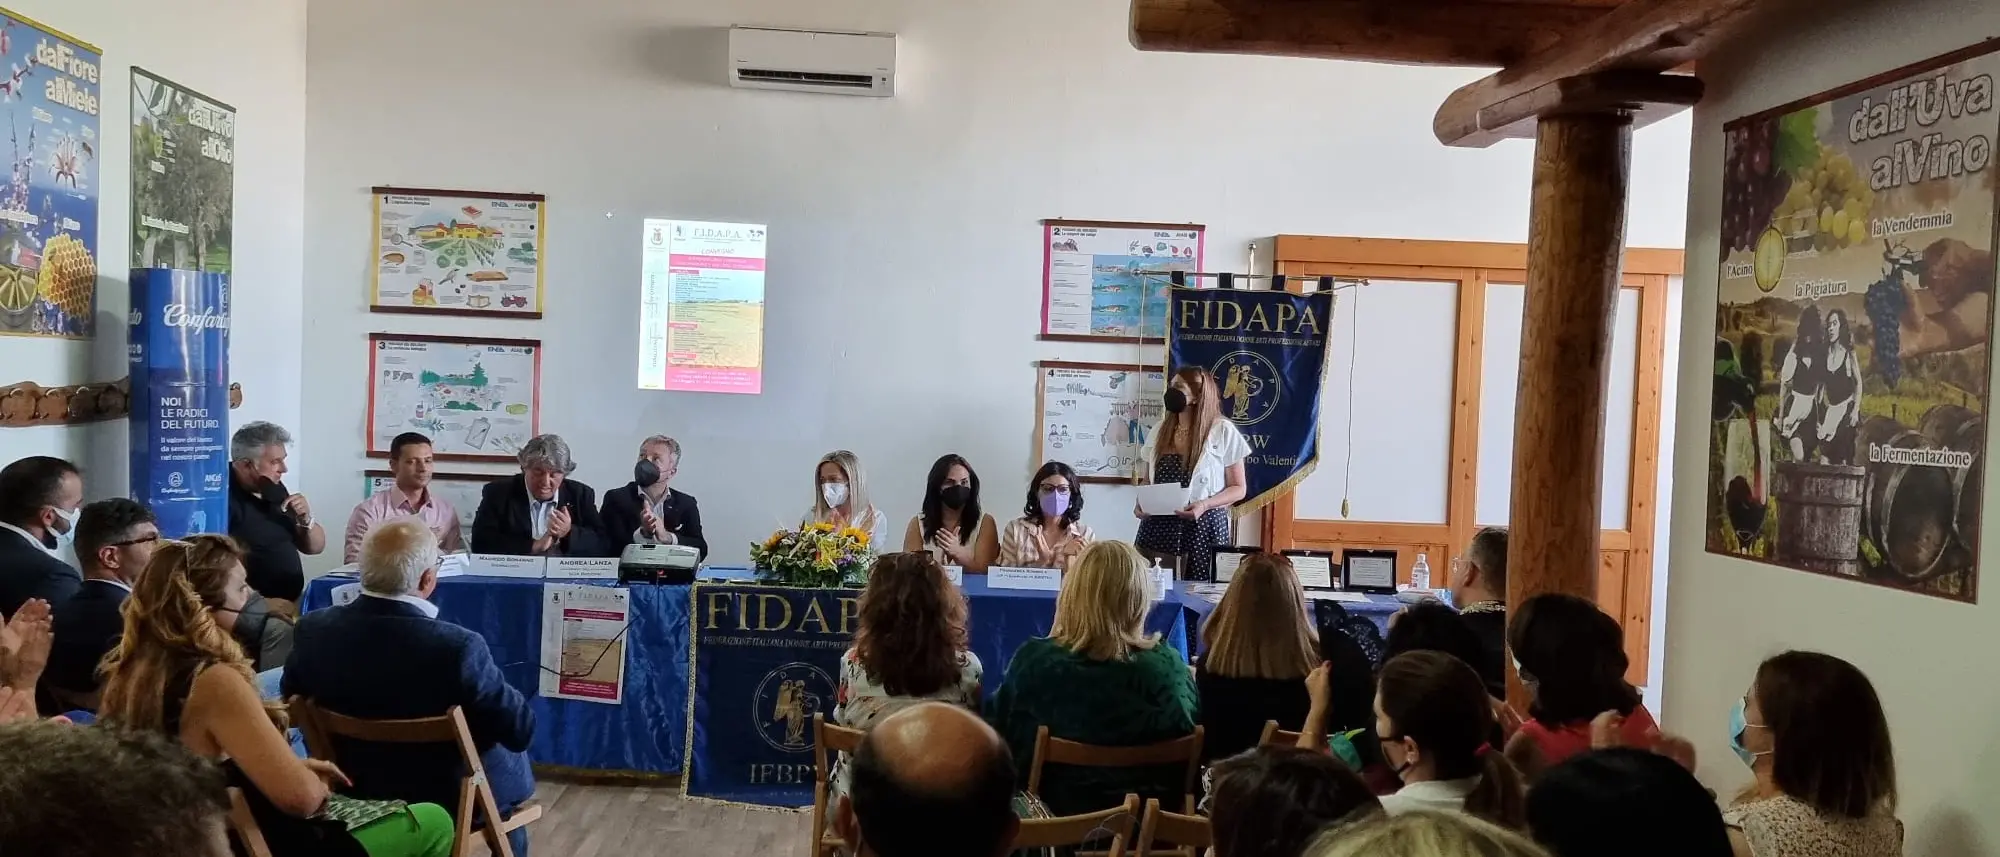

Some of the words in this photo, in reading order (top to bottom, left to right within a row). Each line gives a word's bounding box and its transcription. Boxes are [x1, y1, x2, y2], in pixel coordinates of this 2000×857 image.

[1873, 219, 1883, 236] la
[1884, 211, 1953, 233] Vendemmia
[1053, 227, 1061, 236] 2
[1795, 284, 1804, 296] la
[1804, 280, 1848, 299] Pigiatura
[1179, 299, 1322, 335] FIDAPA
[379, 341, 386, 350] 3
[1047, 369, 1055, 377] 4
[161, 397, 181, 407] NOI
[161, 408, 174, 418] LE
[176, 408, 208, 418] RADICI
[161, 419, 181, 430] DEL
[1262, 454, 1296, 466] Valenti
[1870, 444, 1879, 461] la
[1882, 445, 1971, 467] Fermentazione
[374, 478, 382, 487] 5
[703, 592, 860, 634] FIDAP
[750, 764, 816, 785] IFBP
